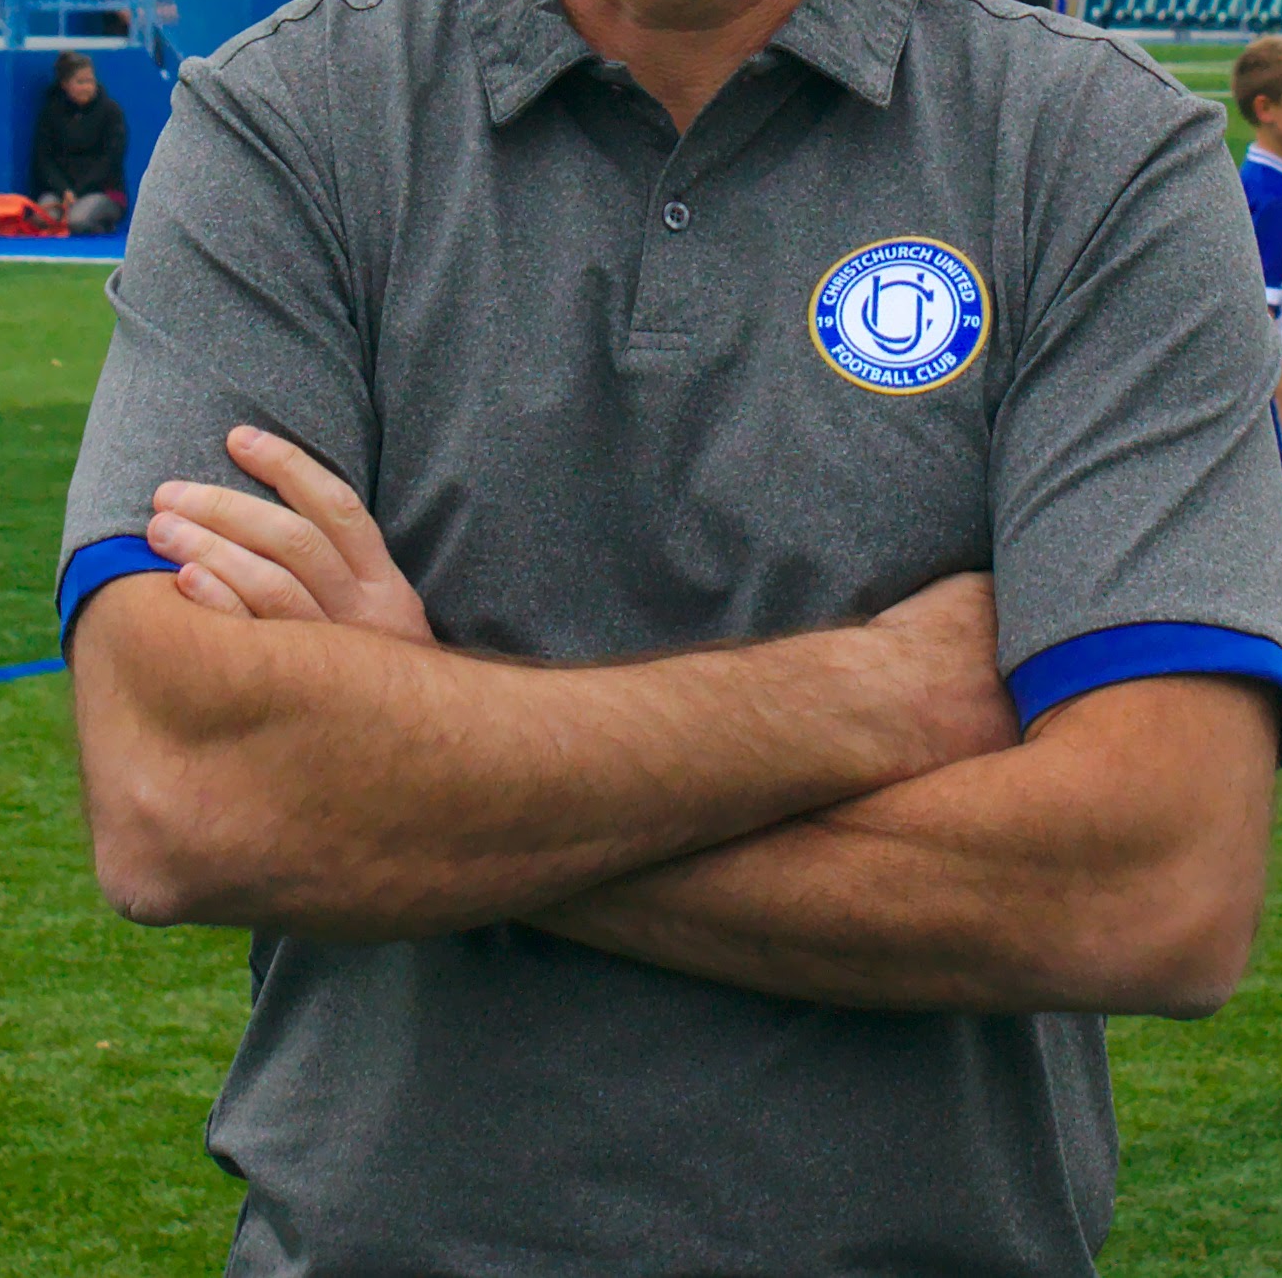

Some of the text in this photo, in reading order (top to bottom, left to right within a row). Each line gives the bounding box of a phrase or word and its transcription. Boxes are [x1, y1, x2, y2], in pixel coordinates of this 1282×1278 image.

[822, 246, 976, 305] CHRISTCHURCH UNITED
[816, 315, 980, 328] 19 70
[830, 342, 958, 385] FOOTBALL CLUB
